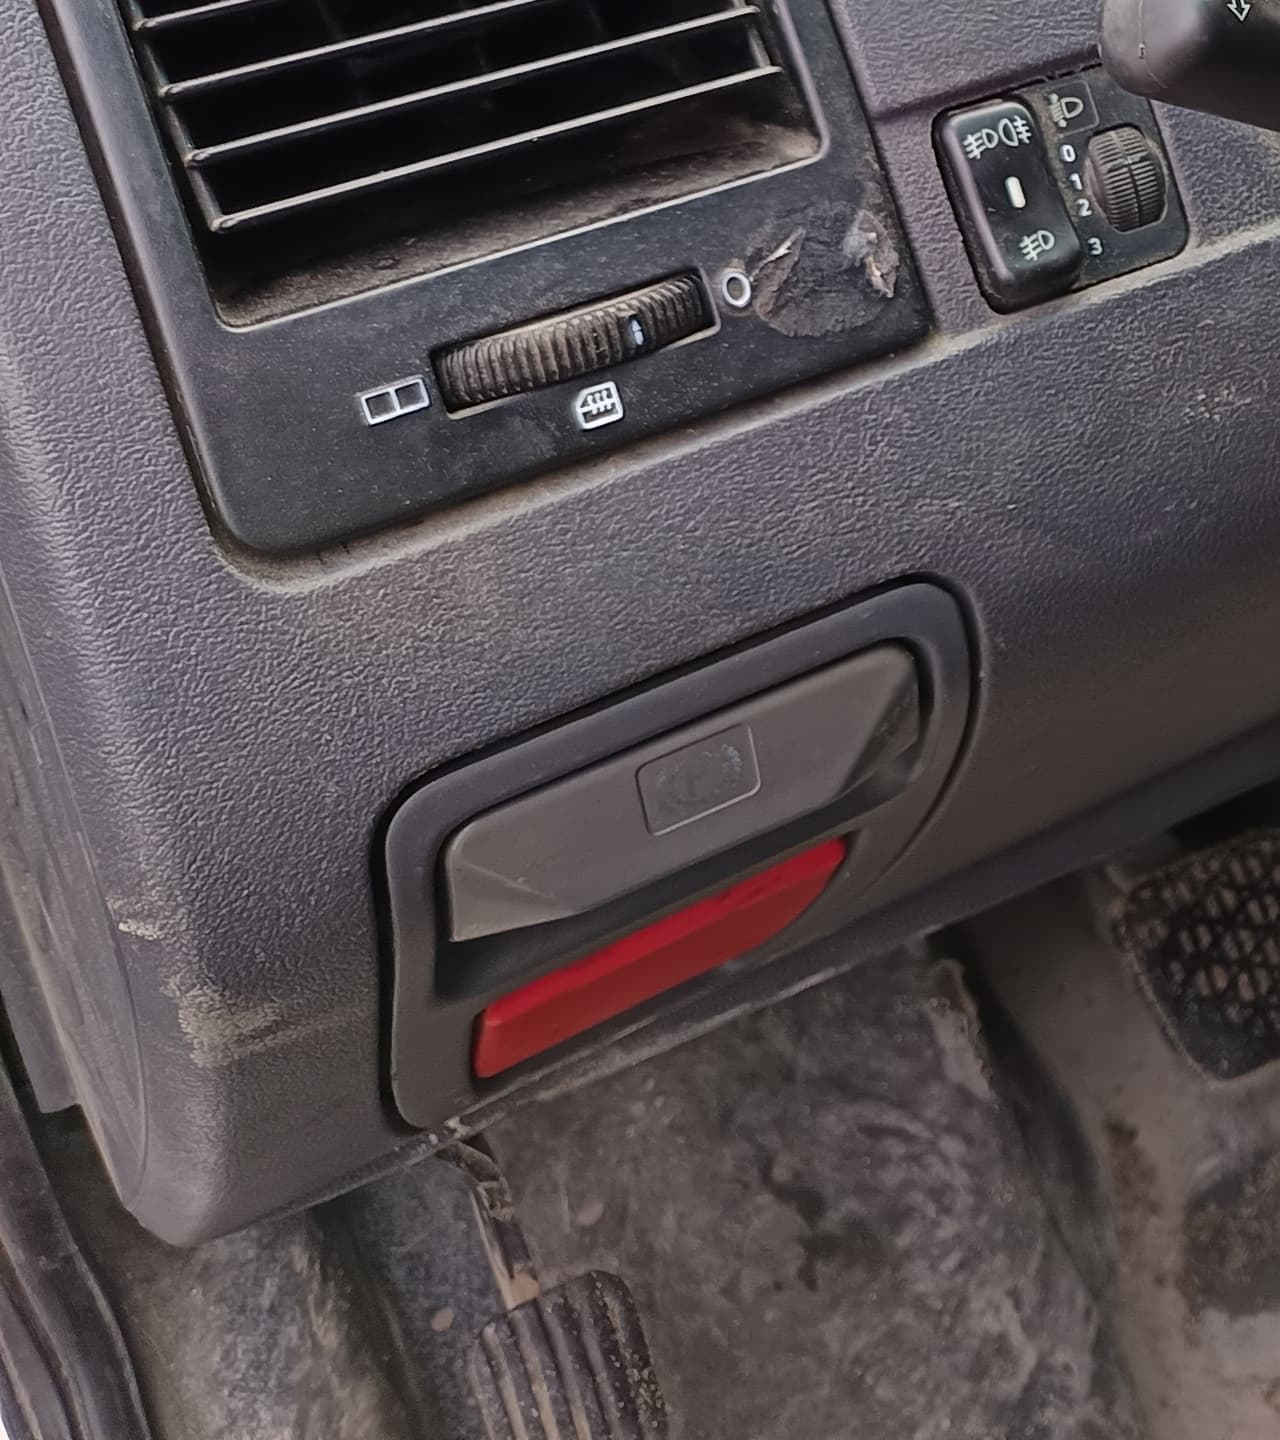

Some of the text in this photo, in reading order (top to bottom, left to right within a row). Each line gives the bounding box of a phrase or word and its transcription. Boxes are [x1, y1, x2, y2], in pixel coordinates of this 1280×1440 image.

[1060, 144, 1076, 163] 0
[1069, 173, 1083, 191] 1
[1075, 198, 1092, 217] 2
[1087, 237, 1103, 256] 3
